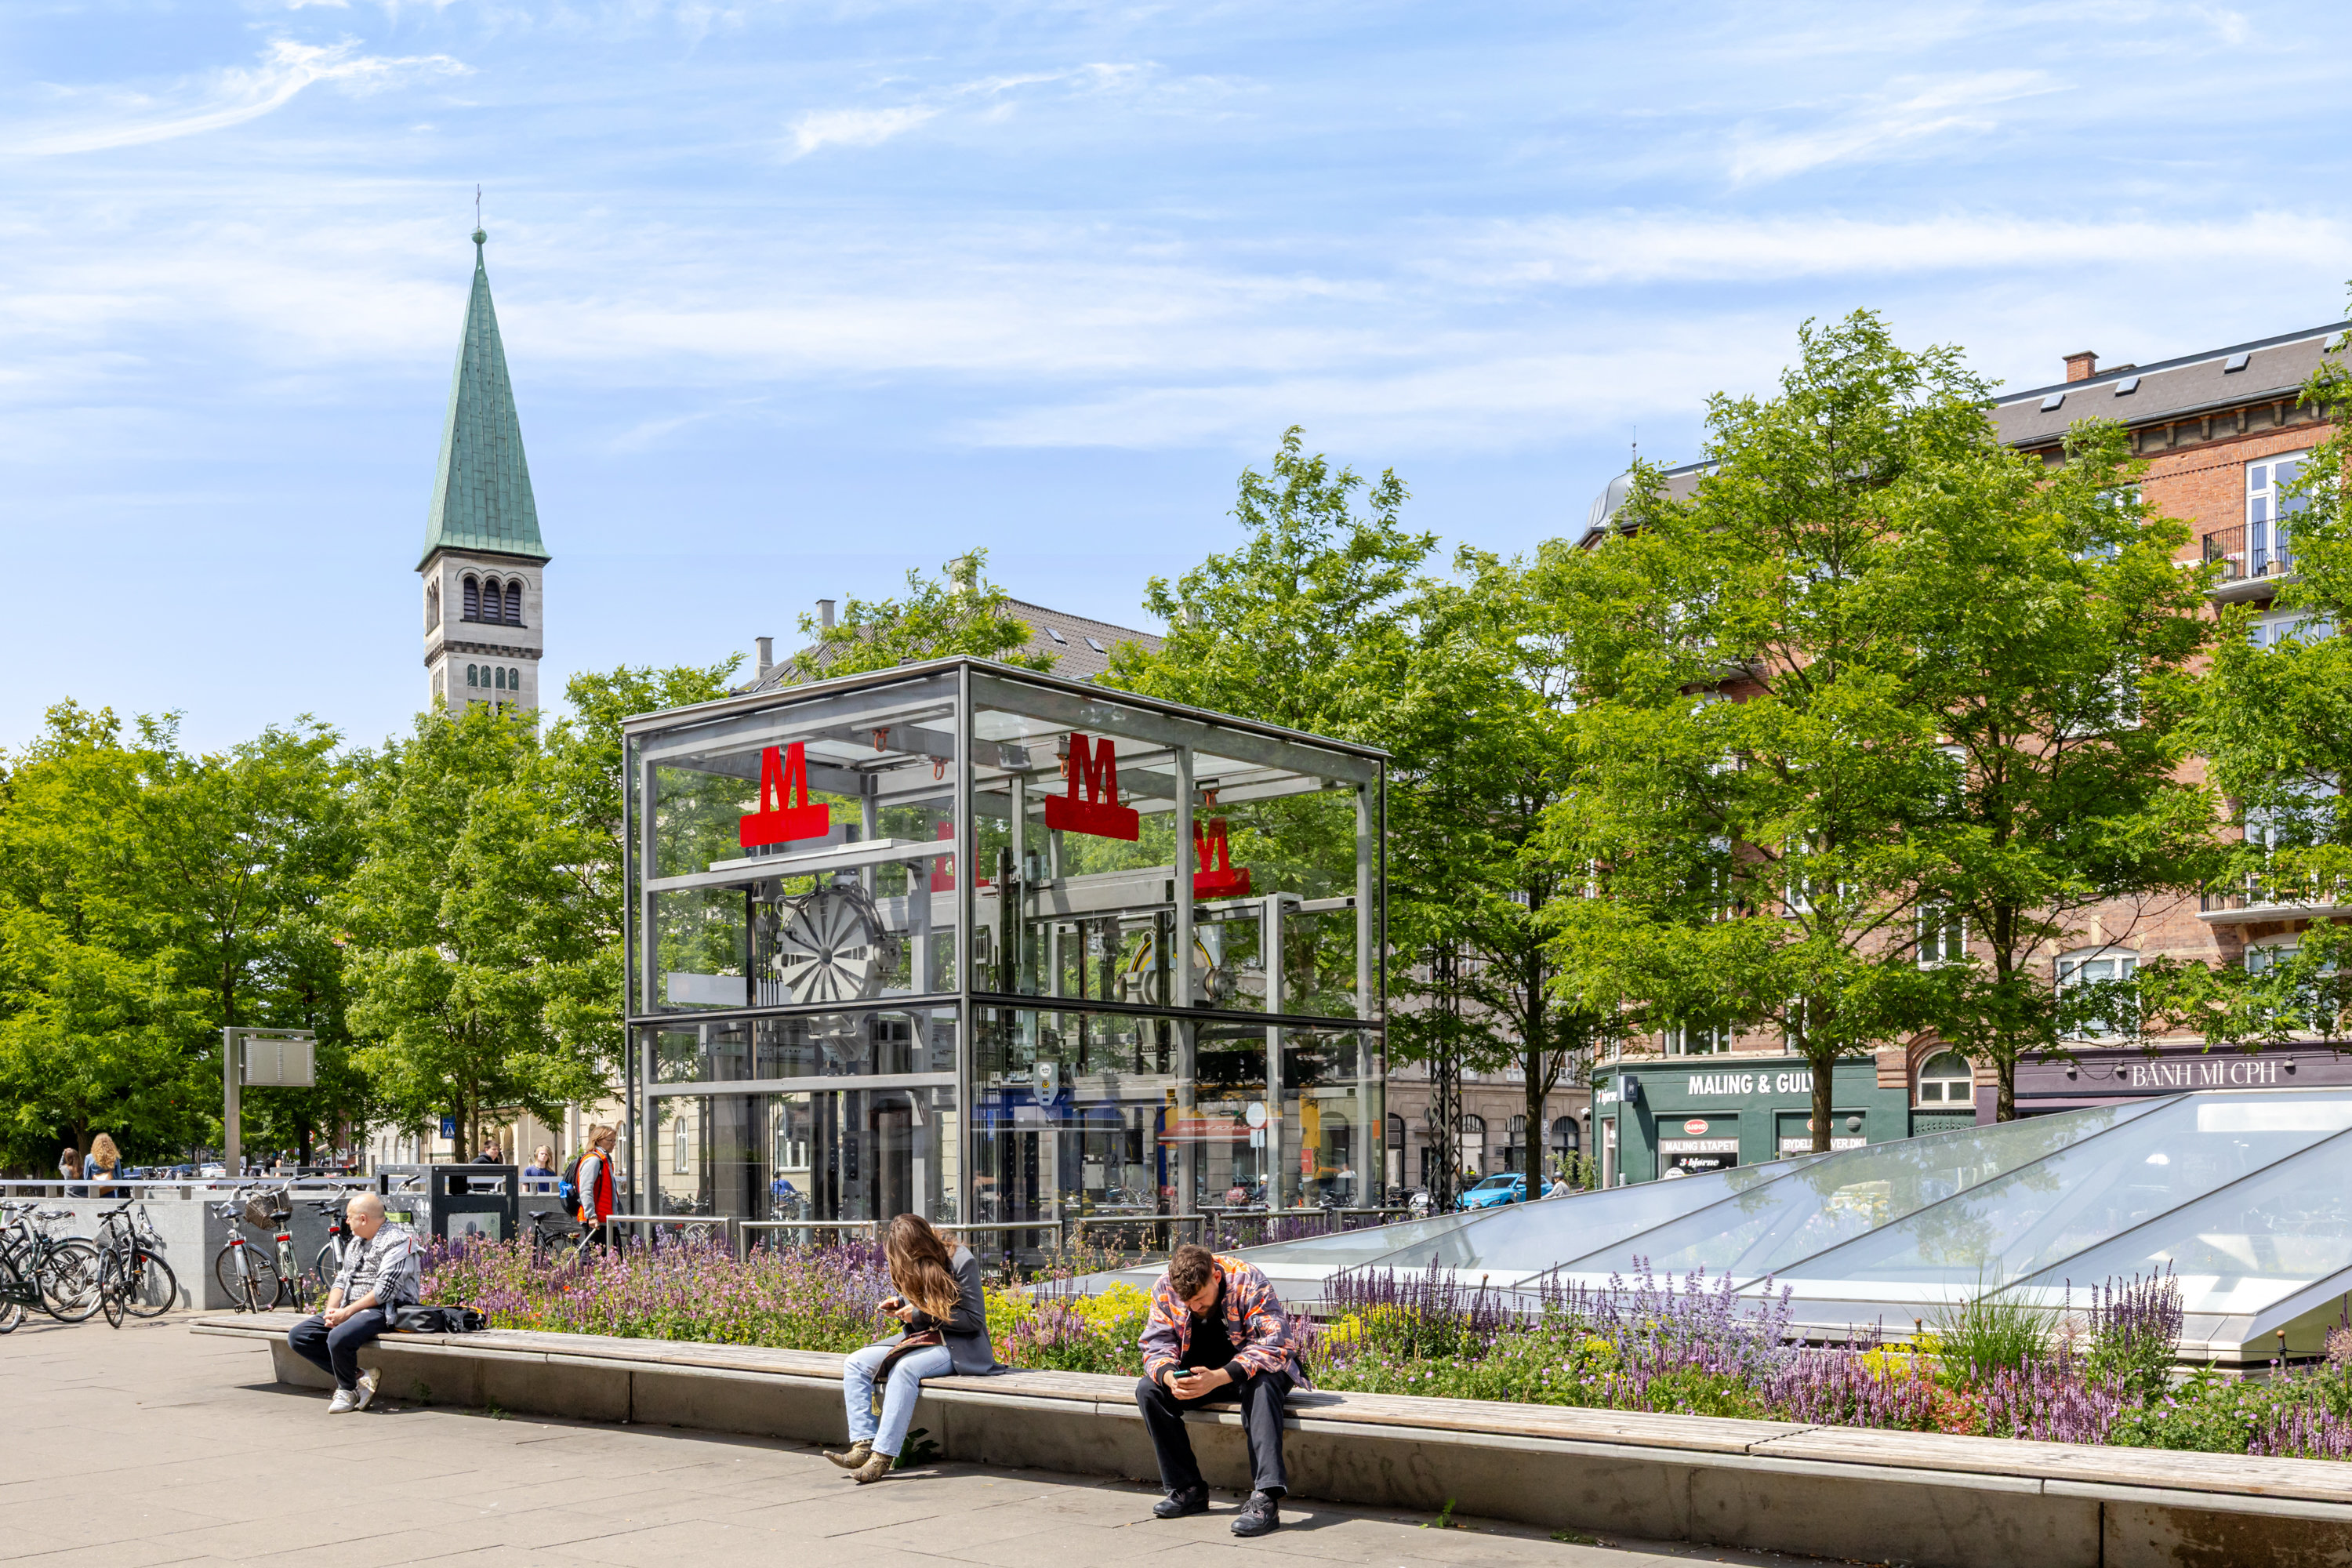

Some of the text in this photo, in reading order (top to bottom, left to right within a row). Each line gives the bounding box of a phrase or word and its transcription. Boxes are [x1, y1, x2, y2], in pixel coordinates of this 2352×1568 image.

[1688, 1074, 1753, 1095] MALING
[1758, 1075, 1771, 1094] &
[2132, 1062, 2191, 1087] BÁNH
[2230, 1062, 2276, 1084] CPH
[1665, 1142, 1734, 1151] MALING & TAPET
